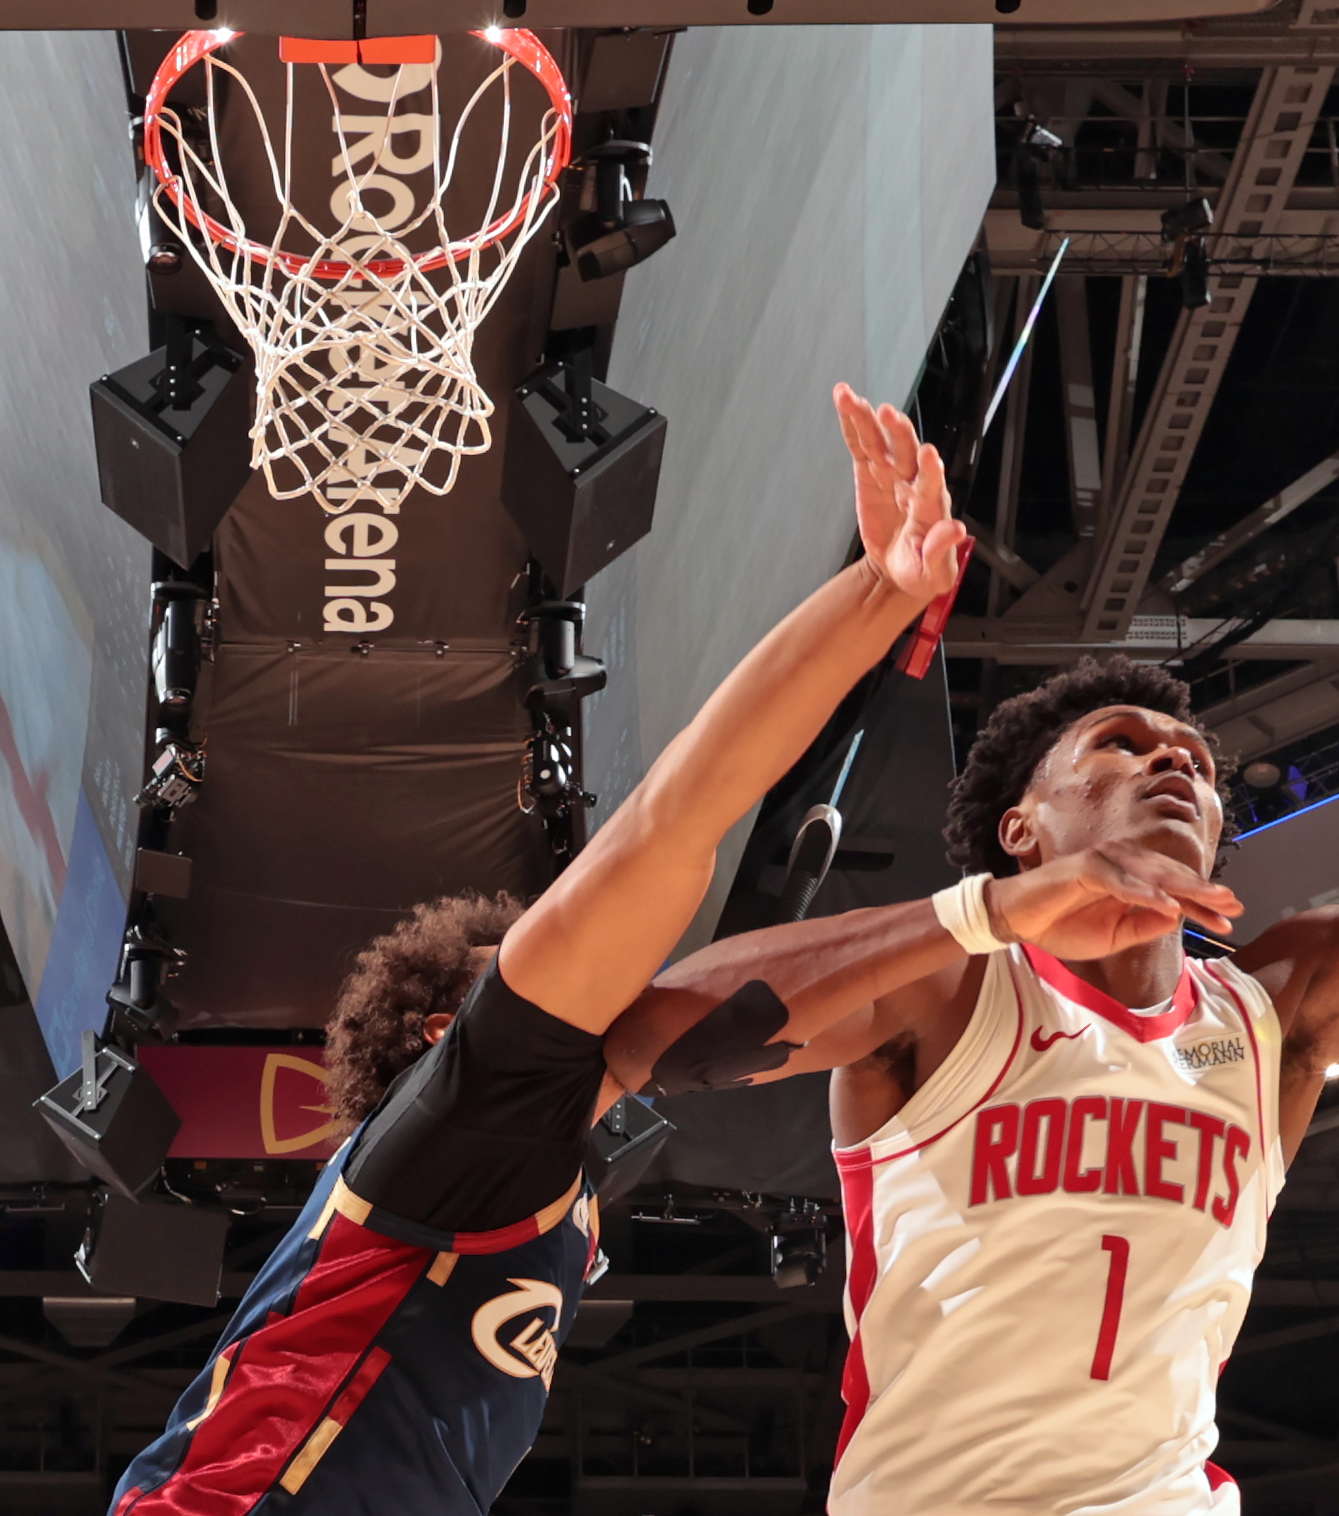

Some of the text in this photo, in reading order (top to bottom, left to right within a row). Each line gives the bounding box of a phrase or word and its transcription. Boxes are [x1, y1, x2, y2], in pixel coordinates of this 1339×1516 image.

[1173, 1037, 1245, 1062] EMORIAL
[1175, 1047, 1245, 1070] ERMANN
[968, 1094, 1252, 1230] ROCKETS
[1090, 1234, 1130, 1381] 1
